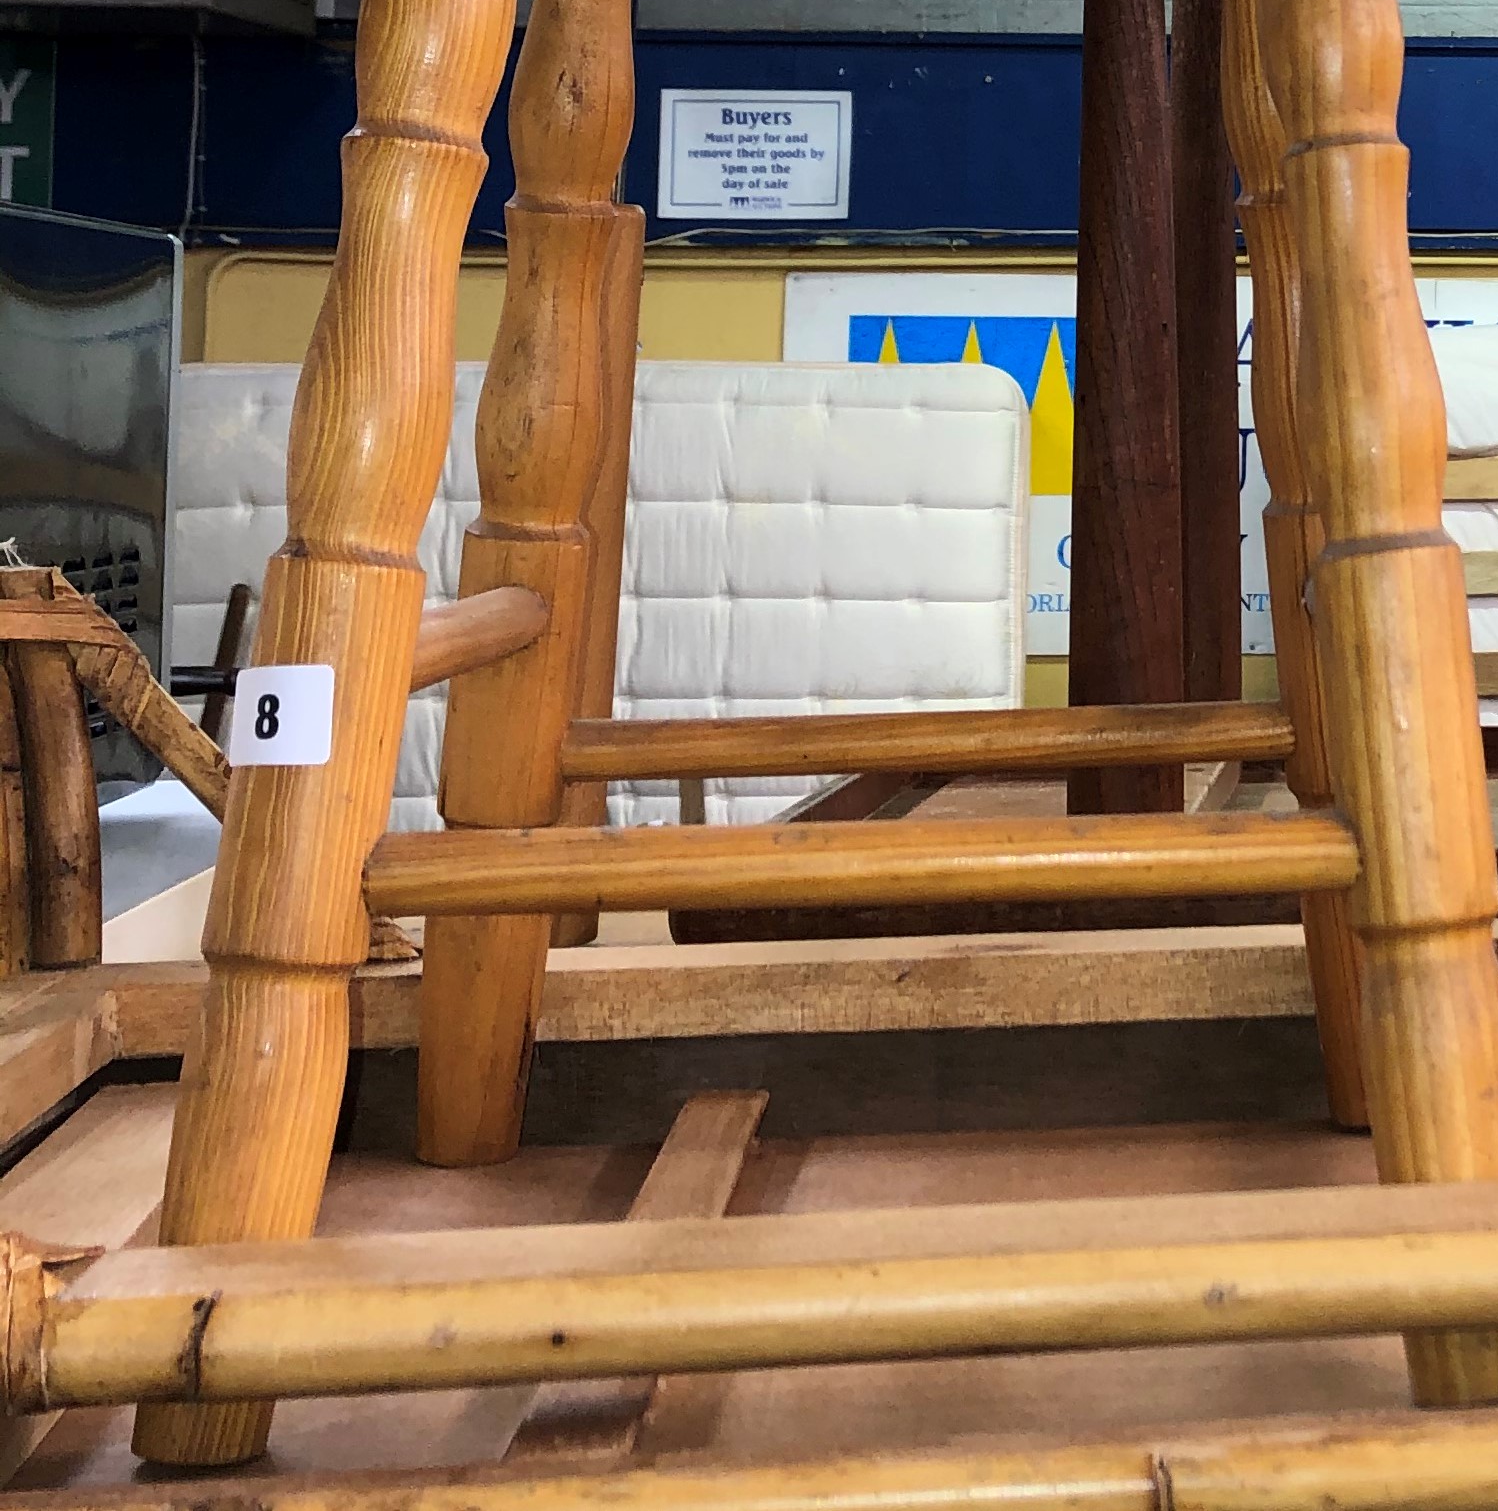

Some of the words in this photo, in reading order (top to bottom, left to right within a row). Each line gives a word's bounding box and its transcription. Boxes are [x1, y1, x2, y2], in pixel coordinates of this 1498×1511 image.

[721, 108, 792, 129] Buyers
[704, 133, 734, 143] Must
[739, 134, 759, 146] pay
[763, 133, 780, 143] for
[784, 133, 808, 143] and
[687, 150, 733, 158] remove
[736, 148, 765, 158] their
[769, 148, 806, 160] goods
[810, 148, 825, 161] by
[721, 163, 748, 175] 5pm
[751, 165, 767, 174] on
[770, 163, 791, 174] the
[721, 178, 744, 190] day
[747, 178, 761, 189] of
[764, 178, 788, 189] sale
[255, 693, 280, 740] 8
